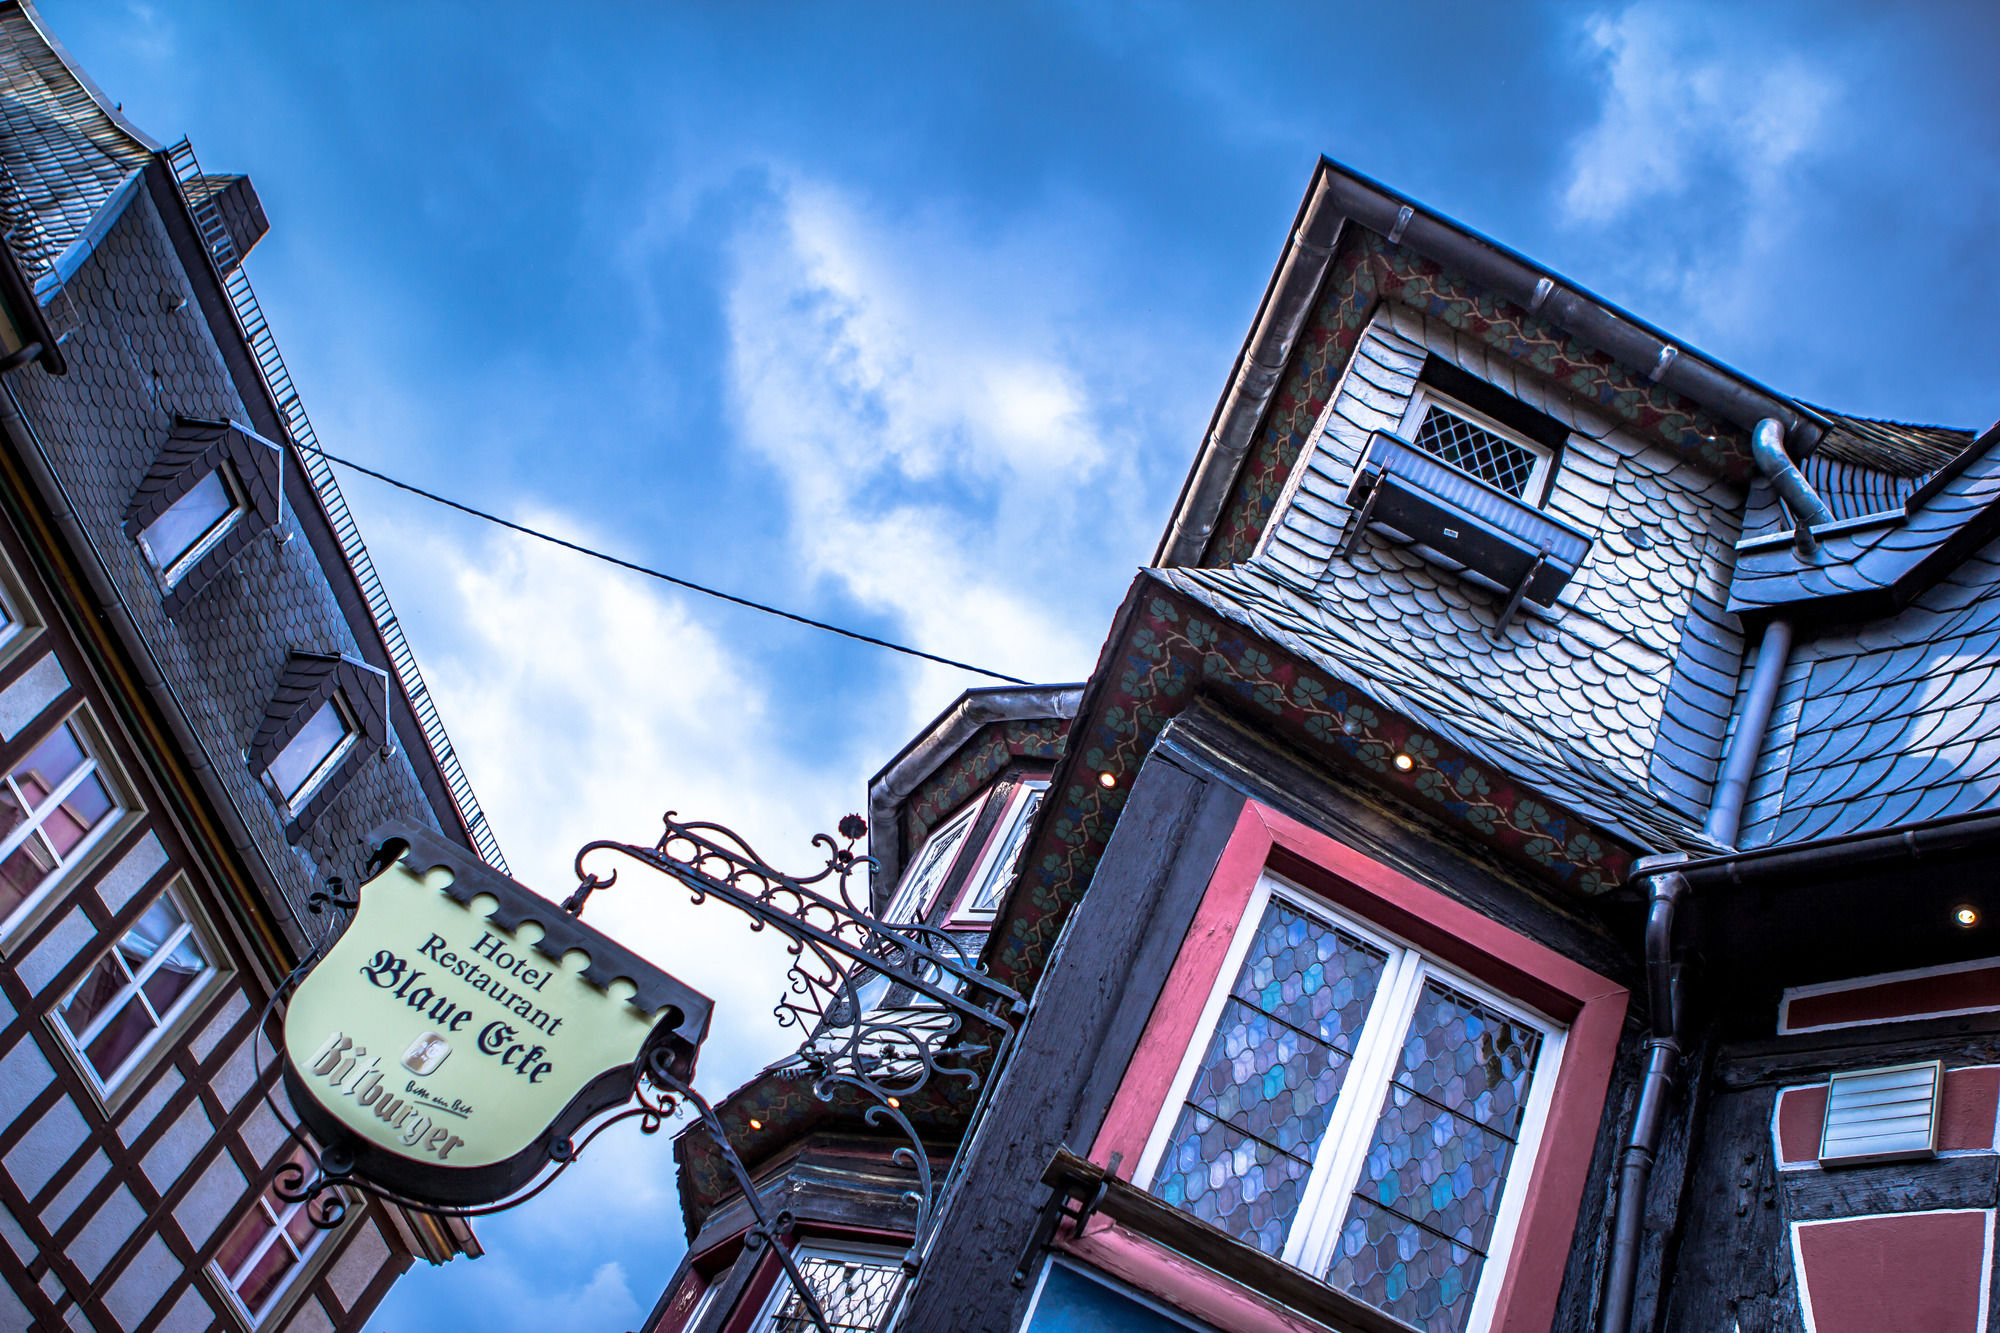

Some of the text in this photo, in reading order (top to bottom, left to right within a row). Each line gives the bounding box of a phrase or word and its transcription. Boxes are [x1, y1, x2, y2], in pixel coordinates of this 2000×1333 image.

[416, 932, 563, 1037] Restaurant
[470, 931, 553, 993] Hotel
[360, 950, 552, 1084] Blaue Ecke
[300, 1031, 465, 1160] Bitburger
[405, 1080, 430, 1099] Bitte
[451, 1099, 473, 1114] Bit
